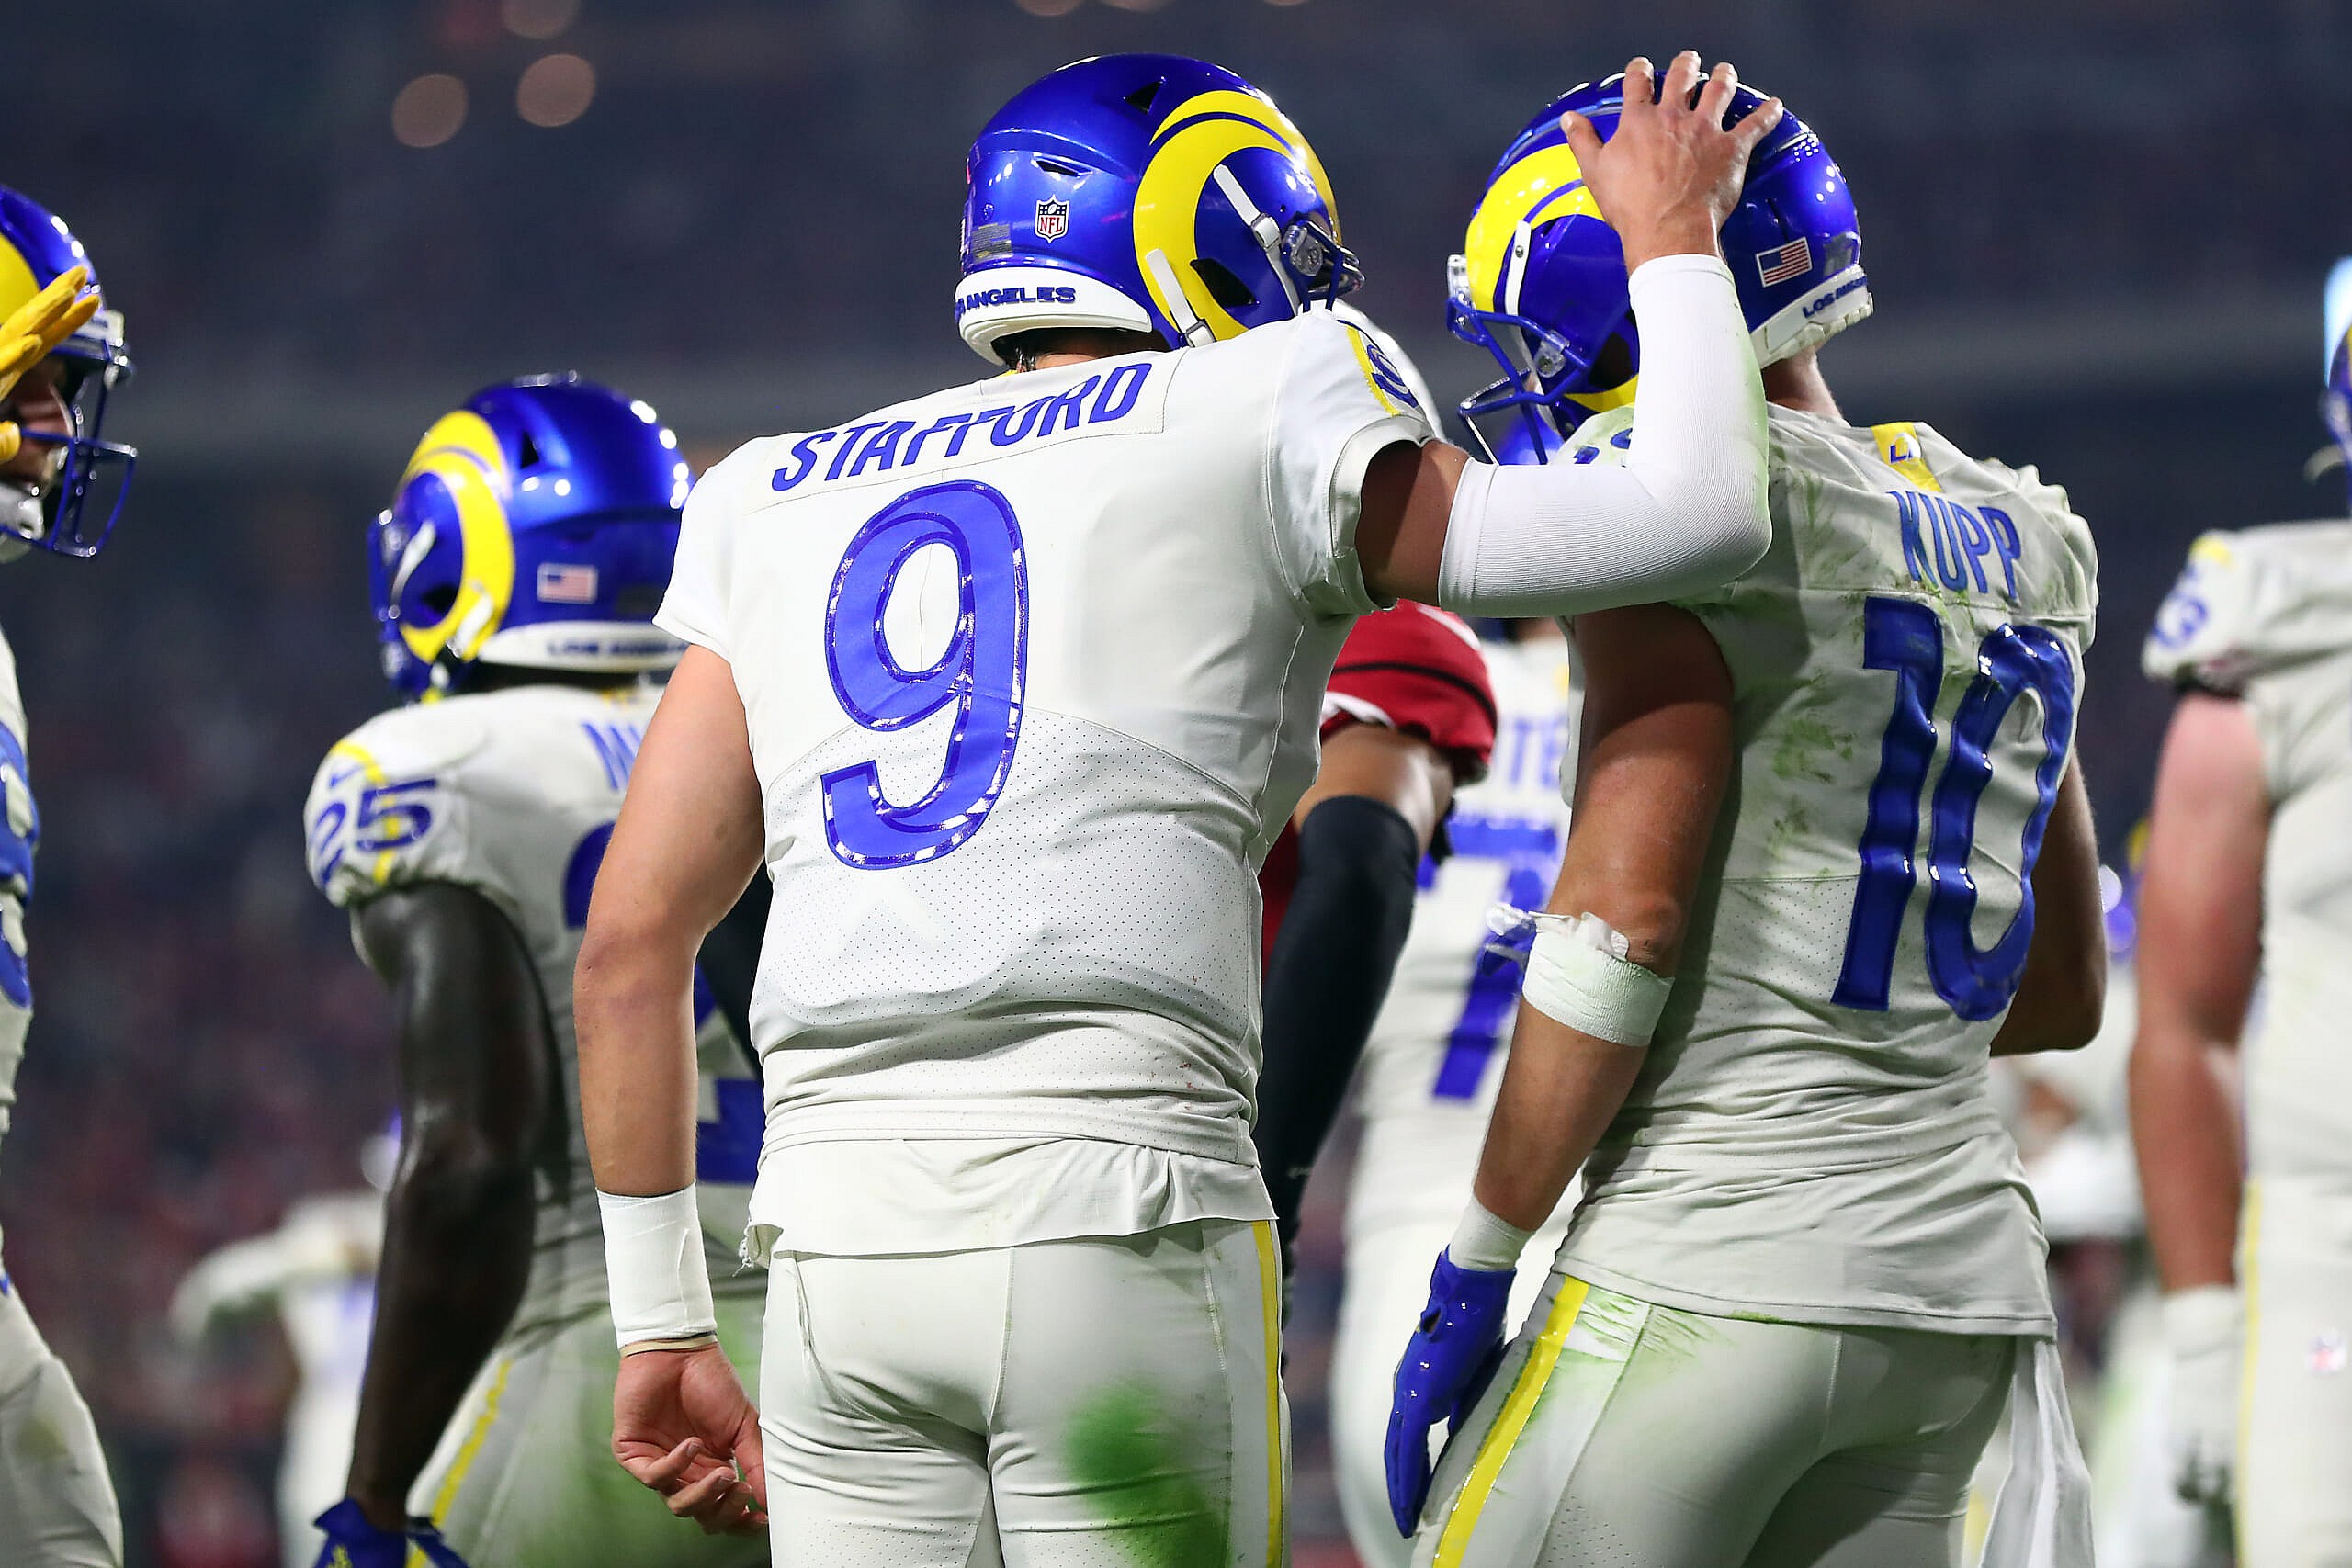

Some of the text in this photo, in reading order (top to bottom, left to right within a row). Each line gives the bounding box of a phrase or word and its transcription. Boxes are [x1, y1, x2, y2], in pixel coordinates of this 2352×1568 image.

[1039, 216, 1063, 233] NFL
[967, 287, 1077, 310] ANGELES
[1803, 293, 1836, 319] LOS
[772, 363, 1152, 492] STAFFORD
[1886, 491, 2021, 601] KUPP
[820, 479, 1029, 871] 9
[309, 778, 438, 886] 25
[1830, 596, 2075, 1021] 10
